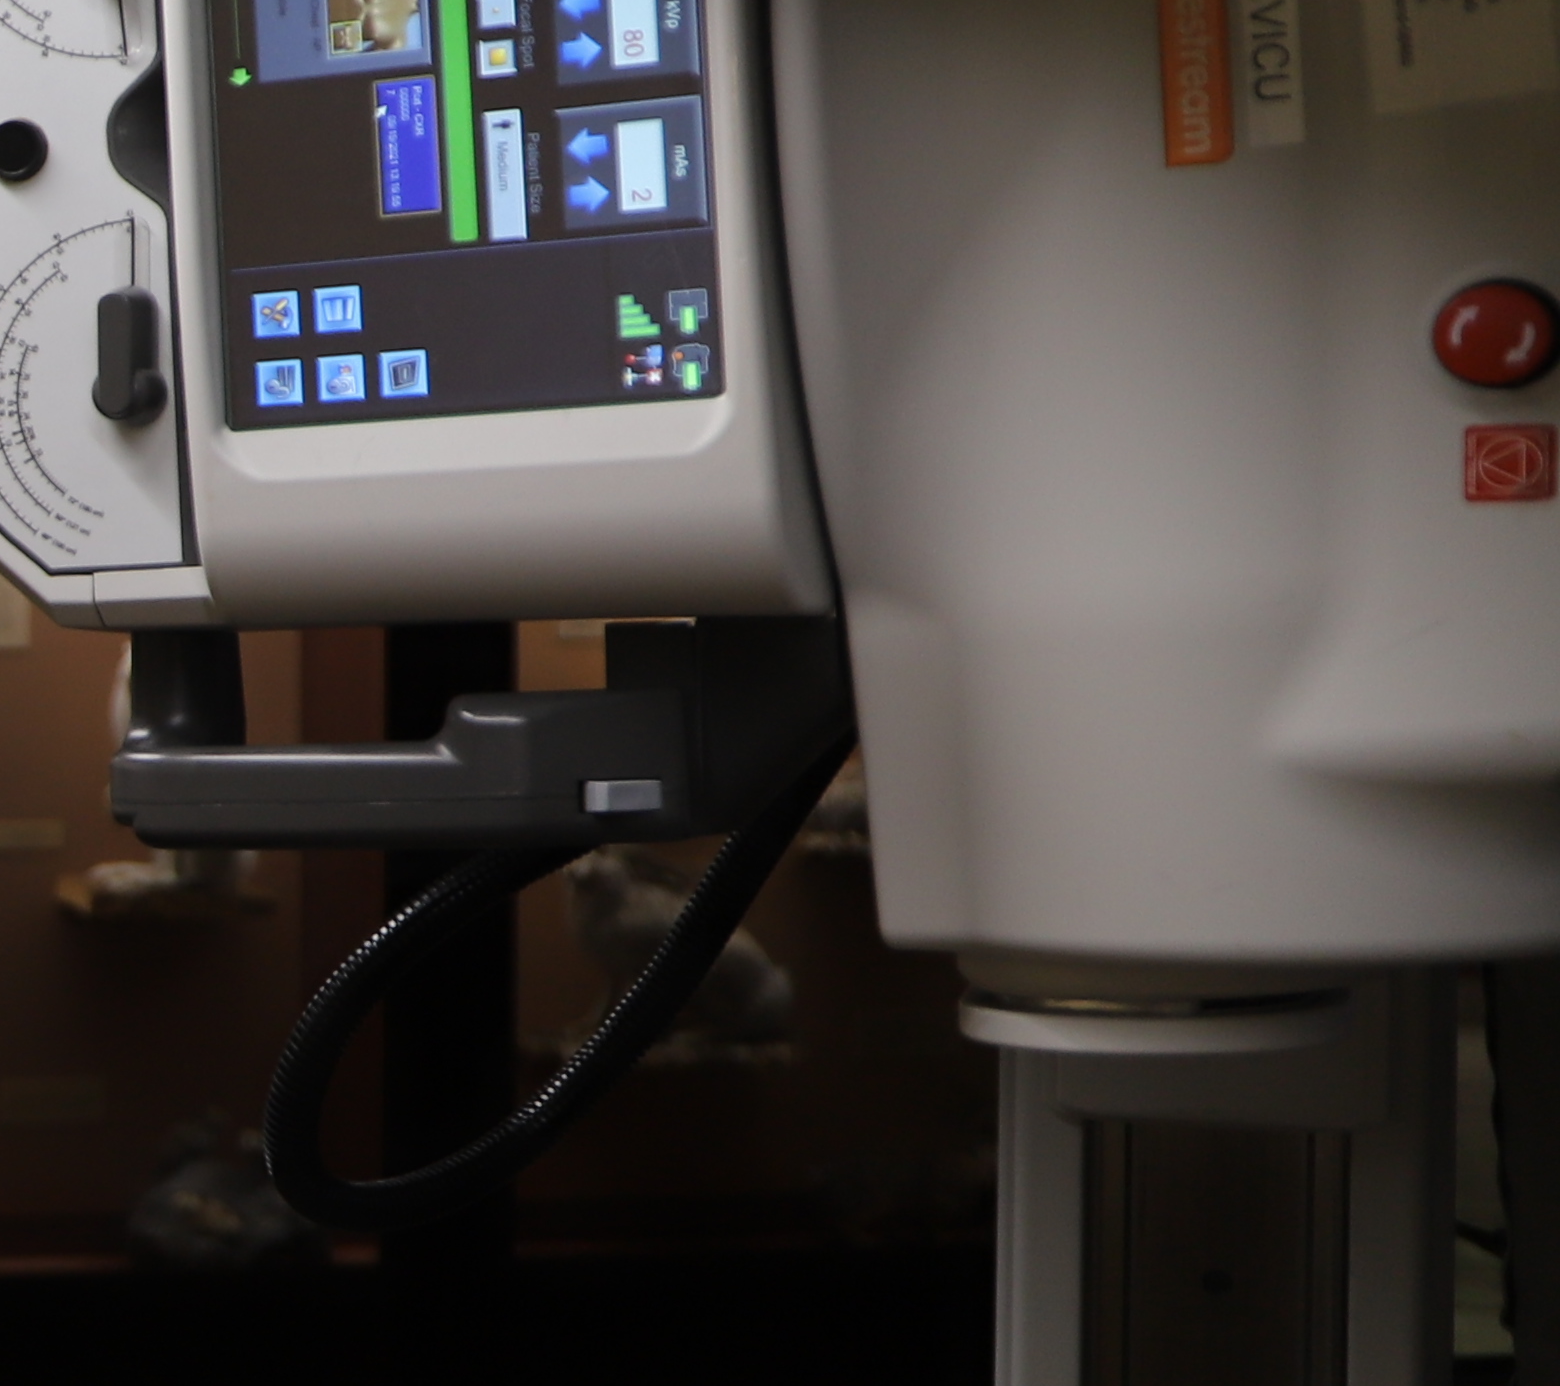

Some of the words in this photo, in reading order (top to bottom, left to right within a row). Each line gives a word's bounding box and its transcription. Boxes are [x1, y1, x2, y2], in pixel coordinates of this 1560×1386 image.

[664, 0, 682, 29] kVp
[520, 36, 535, 68] Spot
[622, 29, 645, 57] 80
[496, 141, 512, 191] Medium
[527, 133, 541, 179] Patient
[674, 145, 689, 177] mAs
[529, 183, 543, 213] Size
[631, 189, 652, 203] 2
